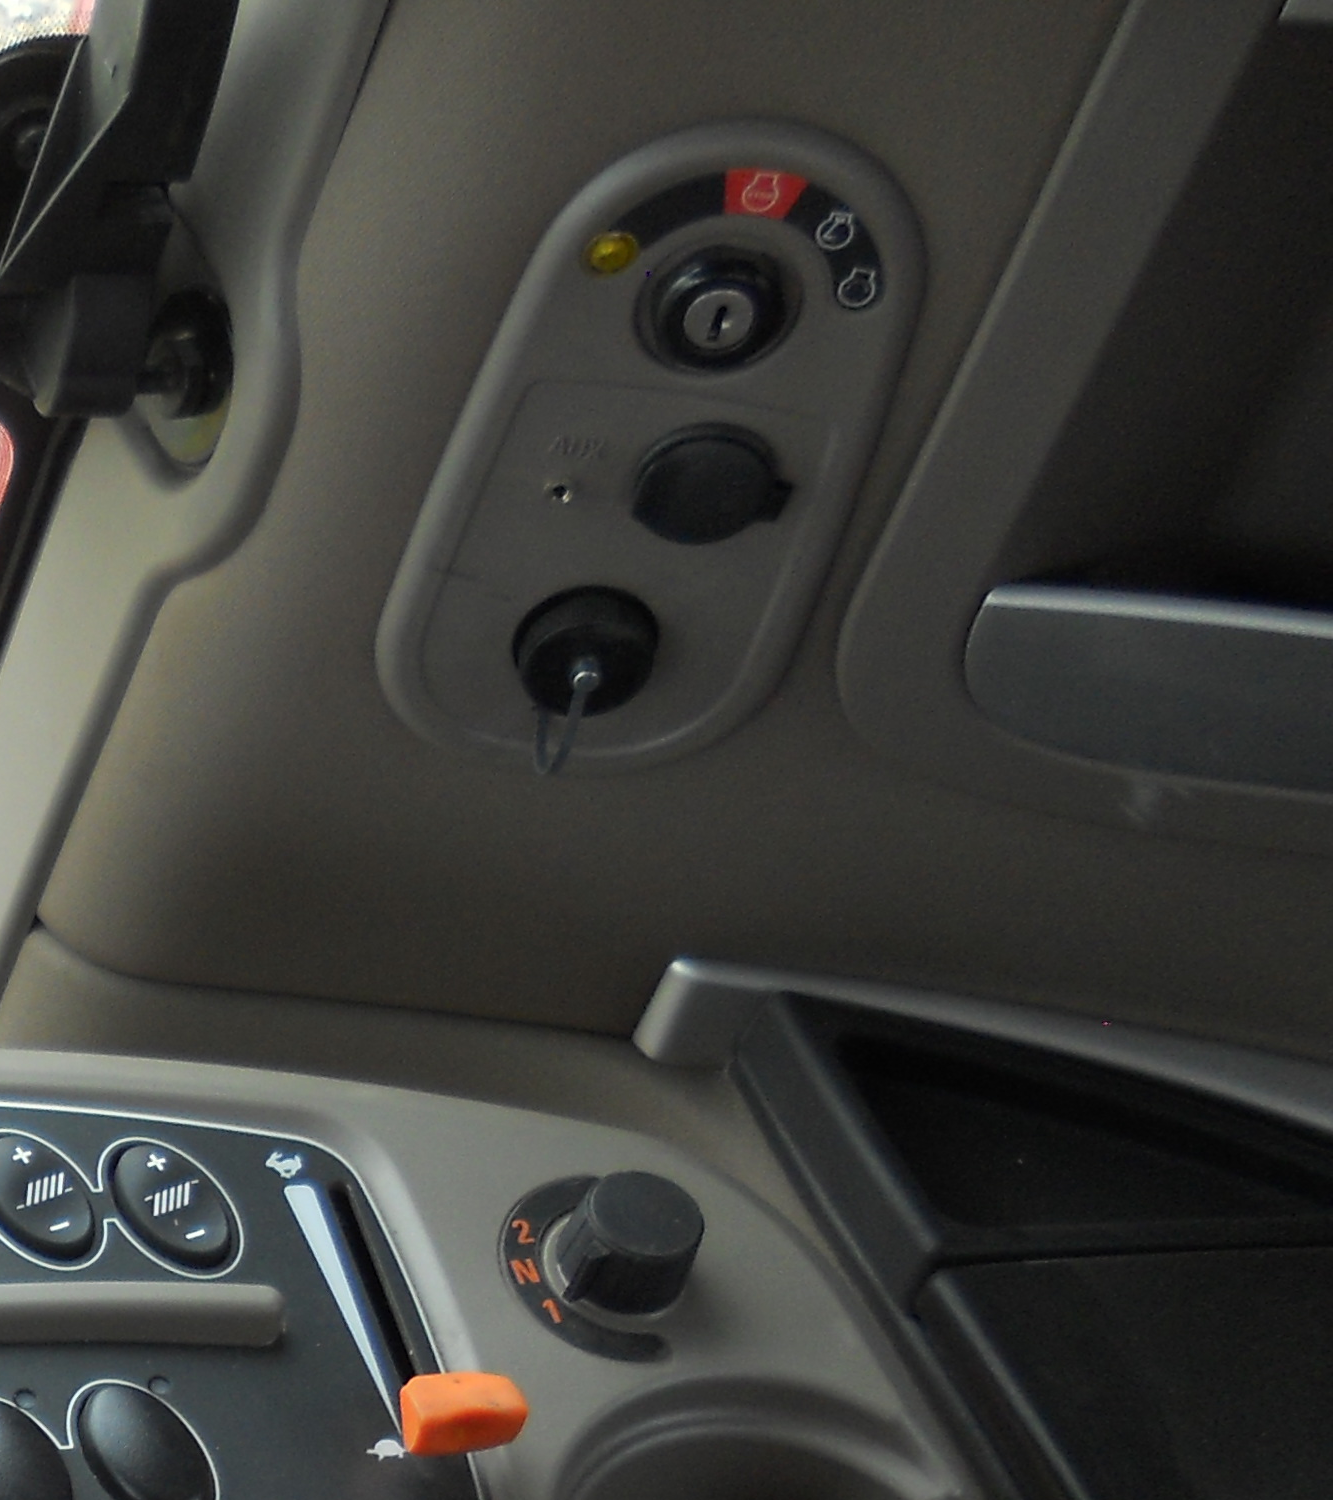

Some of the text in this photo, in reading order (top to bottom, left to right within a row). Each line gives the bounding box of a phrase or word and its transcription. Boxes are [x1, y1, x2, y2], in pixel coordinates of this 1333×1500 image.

[511, 1218, 535, 1244] 2
[509, 1258, 541, 1285] N
[542, 1298, 563, 1324] 1
